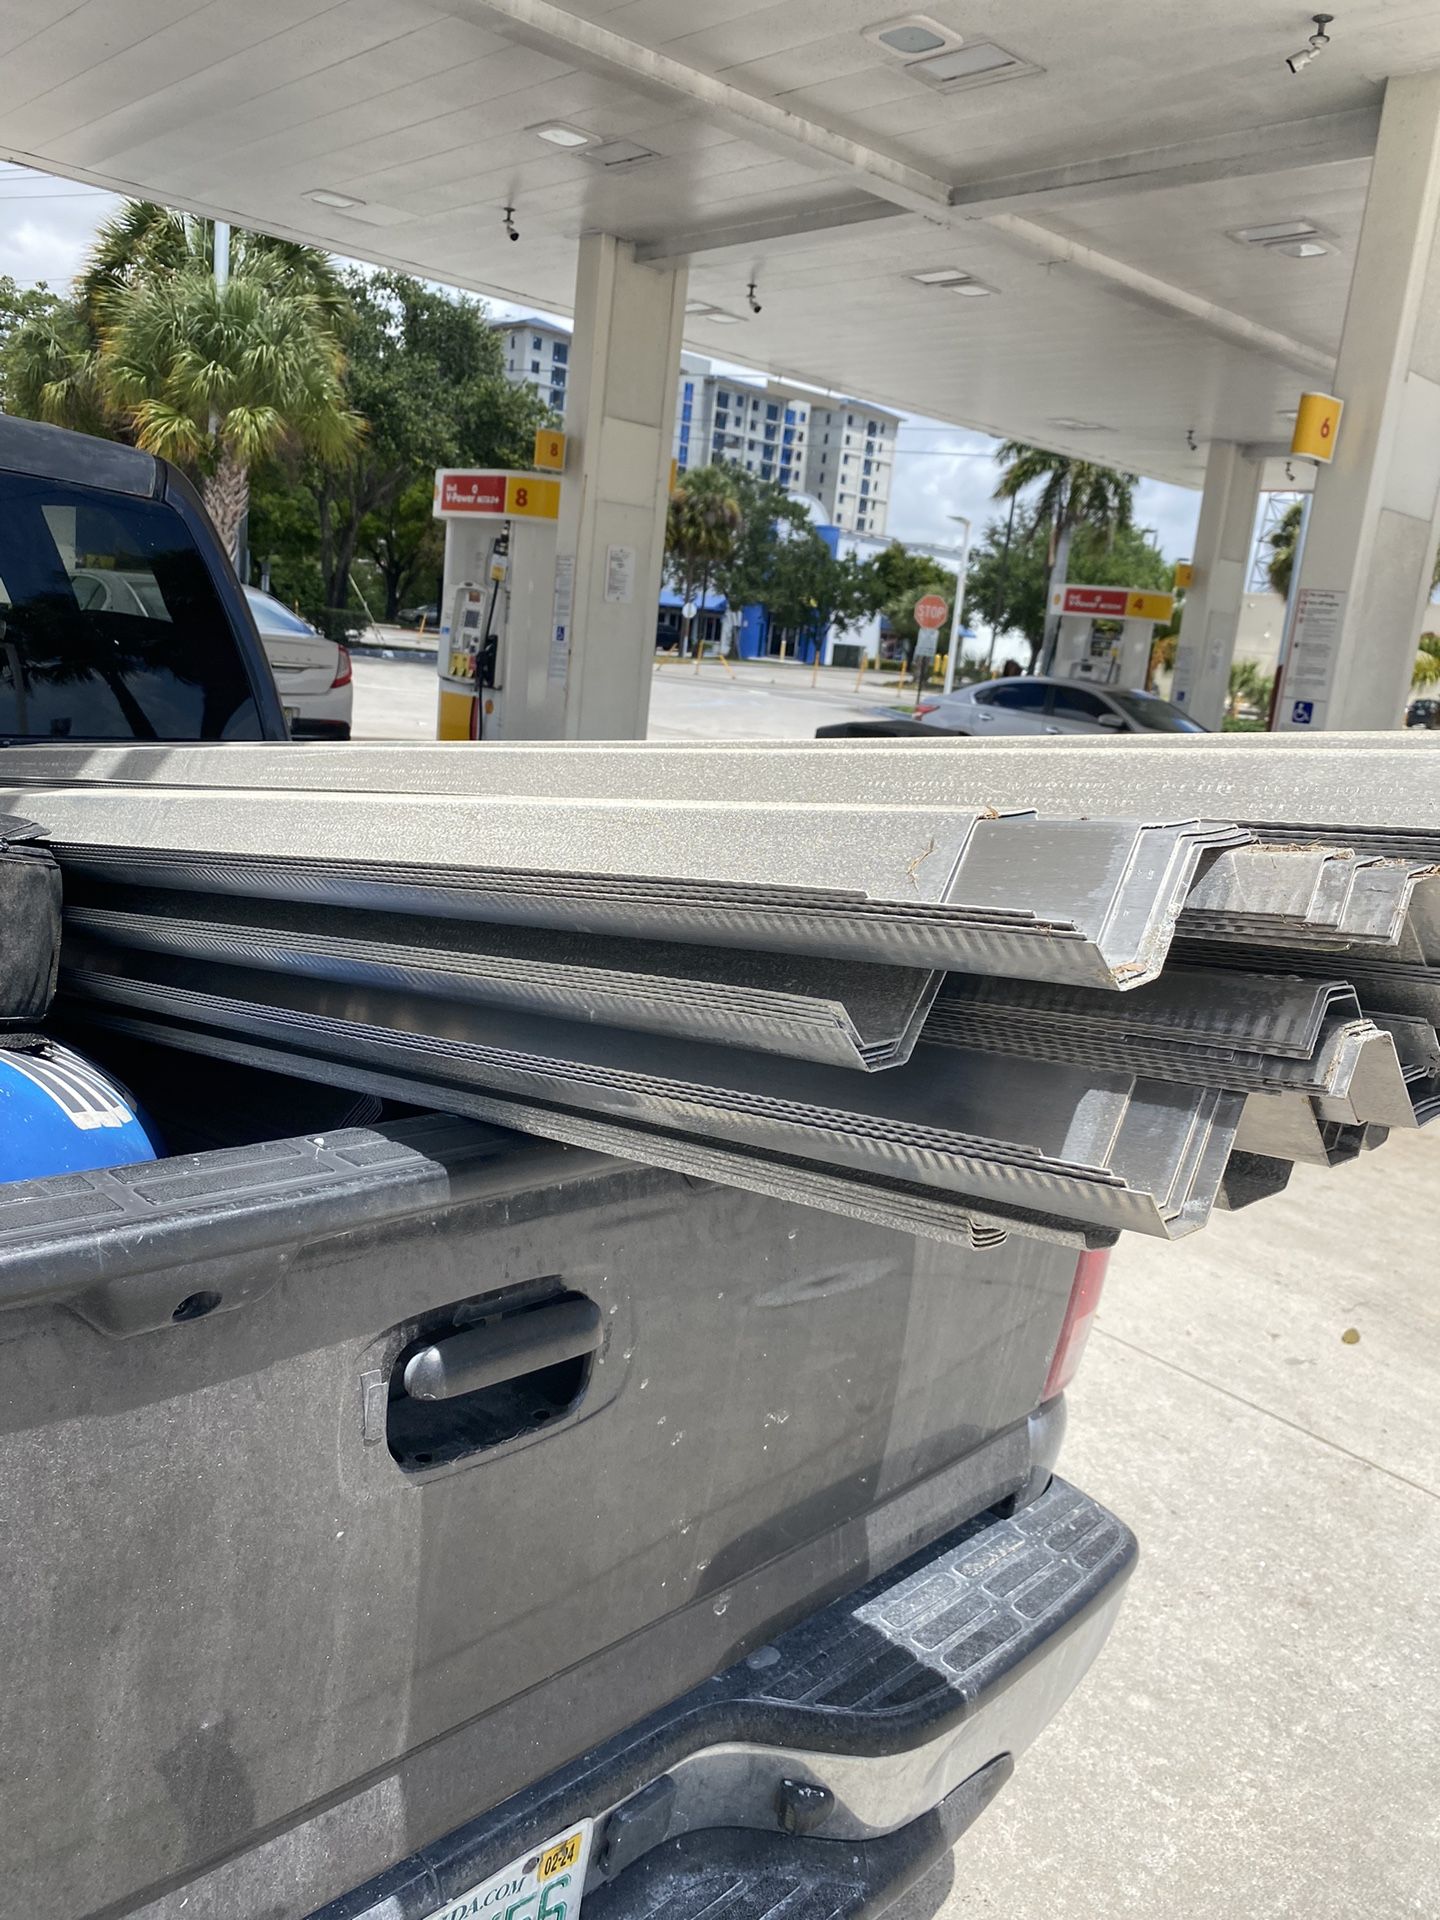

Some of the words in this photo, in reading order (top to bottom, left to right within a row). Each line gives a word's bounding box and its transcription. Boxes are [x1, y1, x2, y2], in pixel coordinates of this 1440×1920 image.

[1320, 417, 1330, 438] 6
[549, 442, 559, 457] 8
[515, 487, 528, 507] 8
[917, 604, 945, 619] STOP
[1133, 597, 1145, 610] 4
[544, 1843, 576, 1876] 02-24
